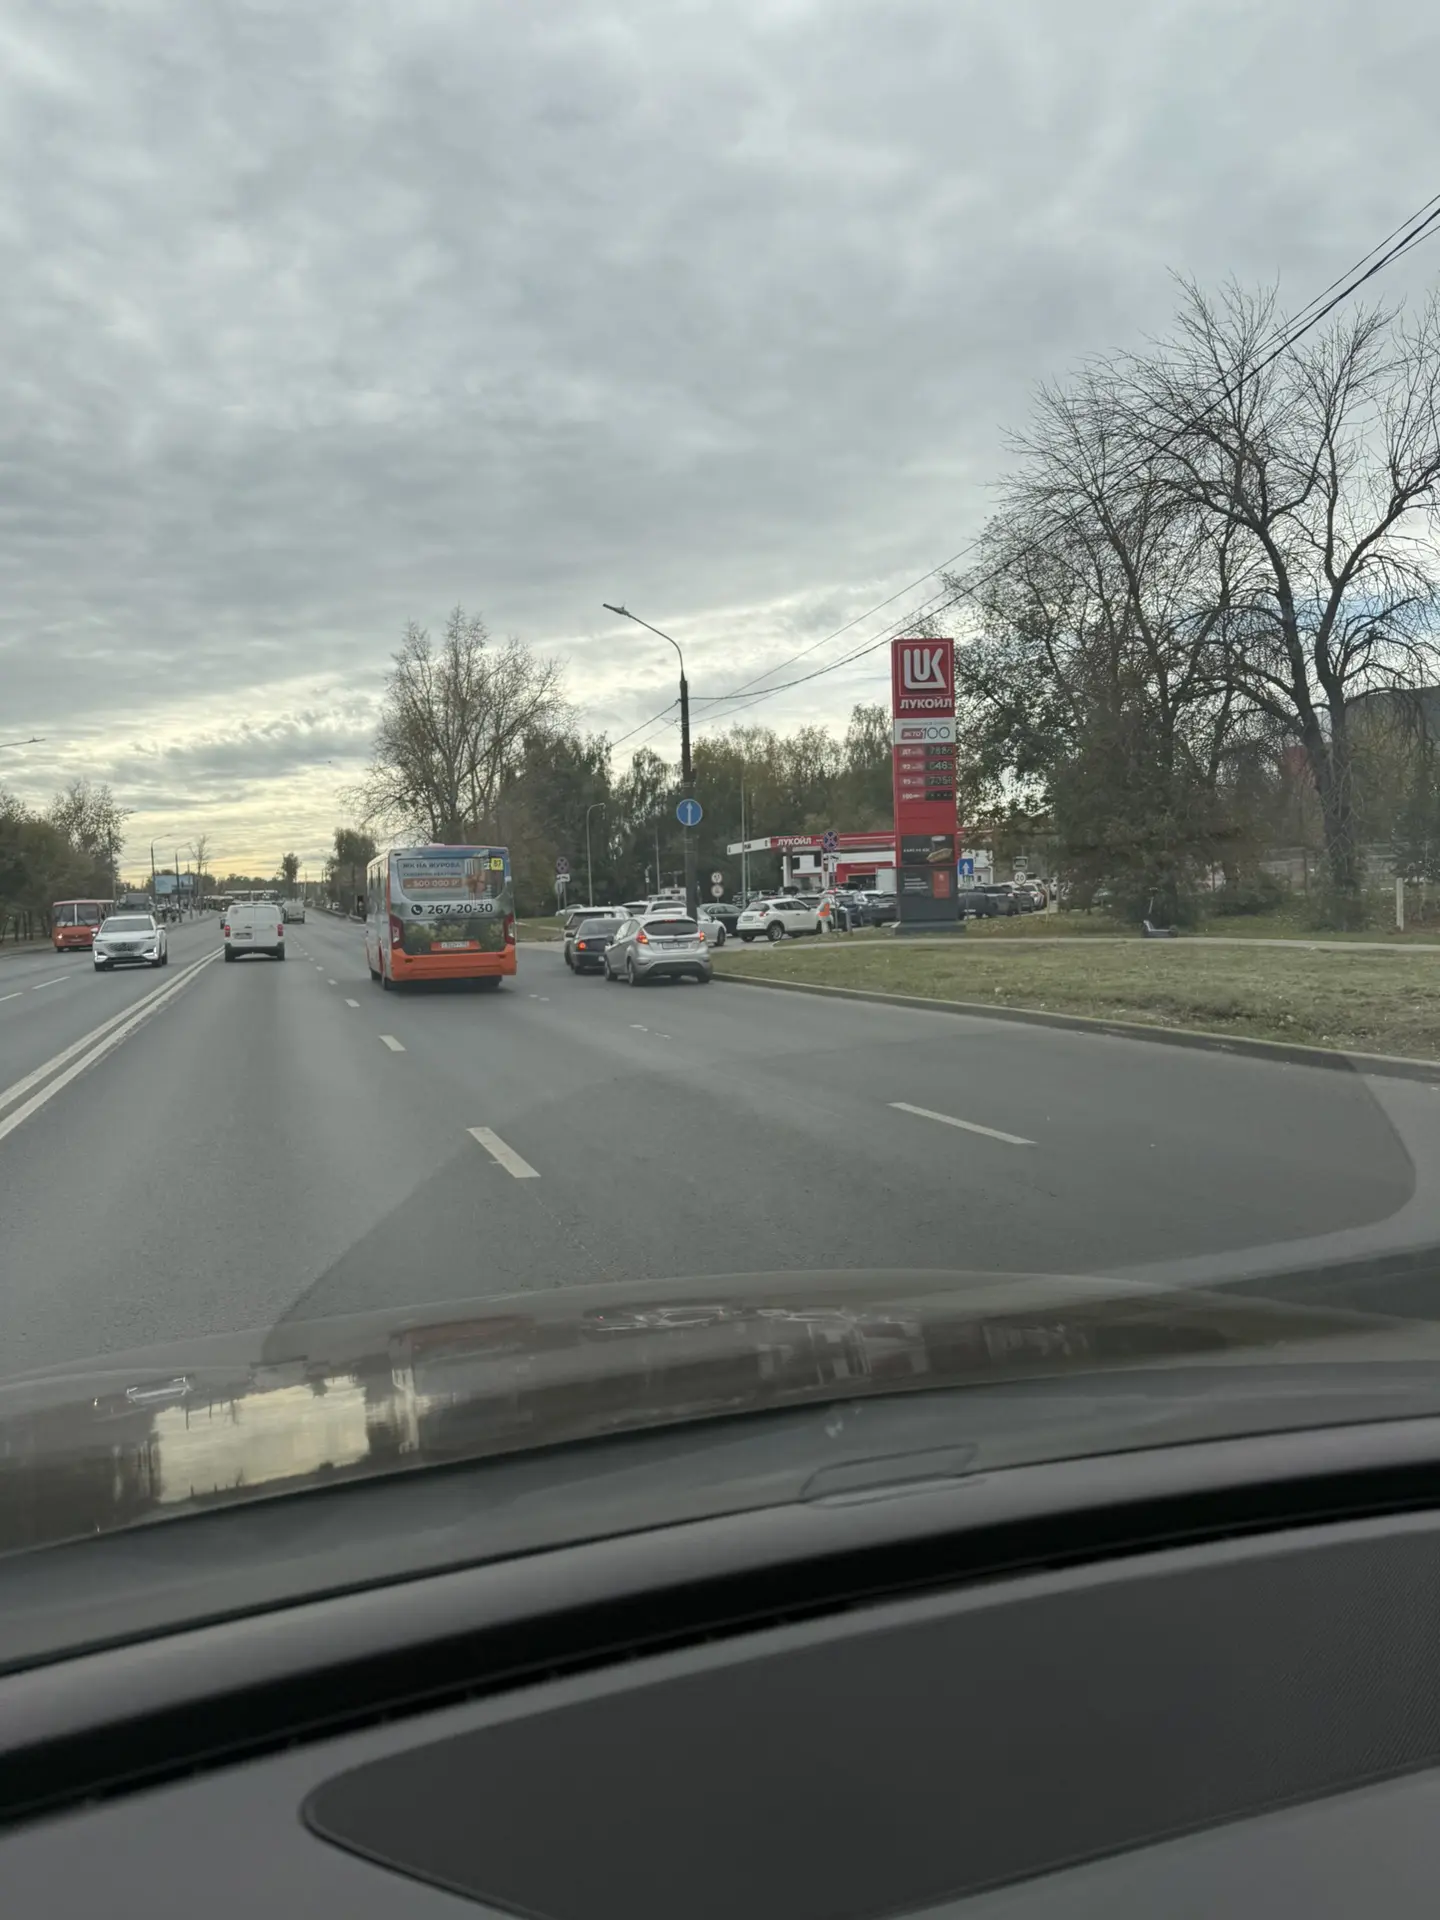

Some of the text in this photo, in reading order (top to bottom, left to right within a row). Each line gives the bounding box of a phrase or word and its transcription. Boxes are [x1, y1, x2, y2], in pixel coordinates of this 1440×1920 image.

[900, 696, 952, 709] ЛУКОЙЛ
[777, 836, 812, 847] ЛУКОЙЛ
[1015, 874, 1025, 882] 20
[427, 903, 493, 915] 267-20-30
